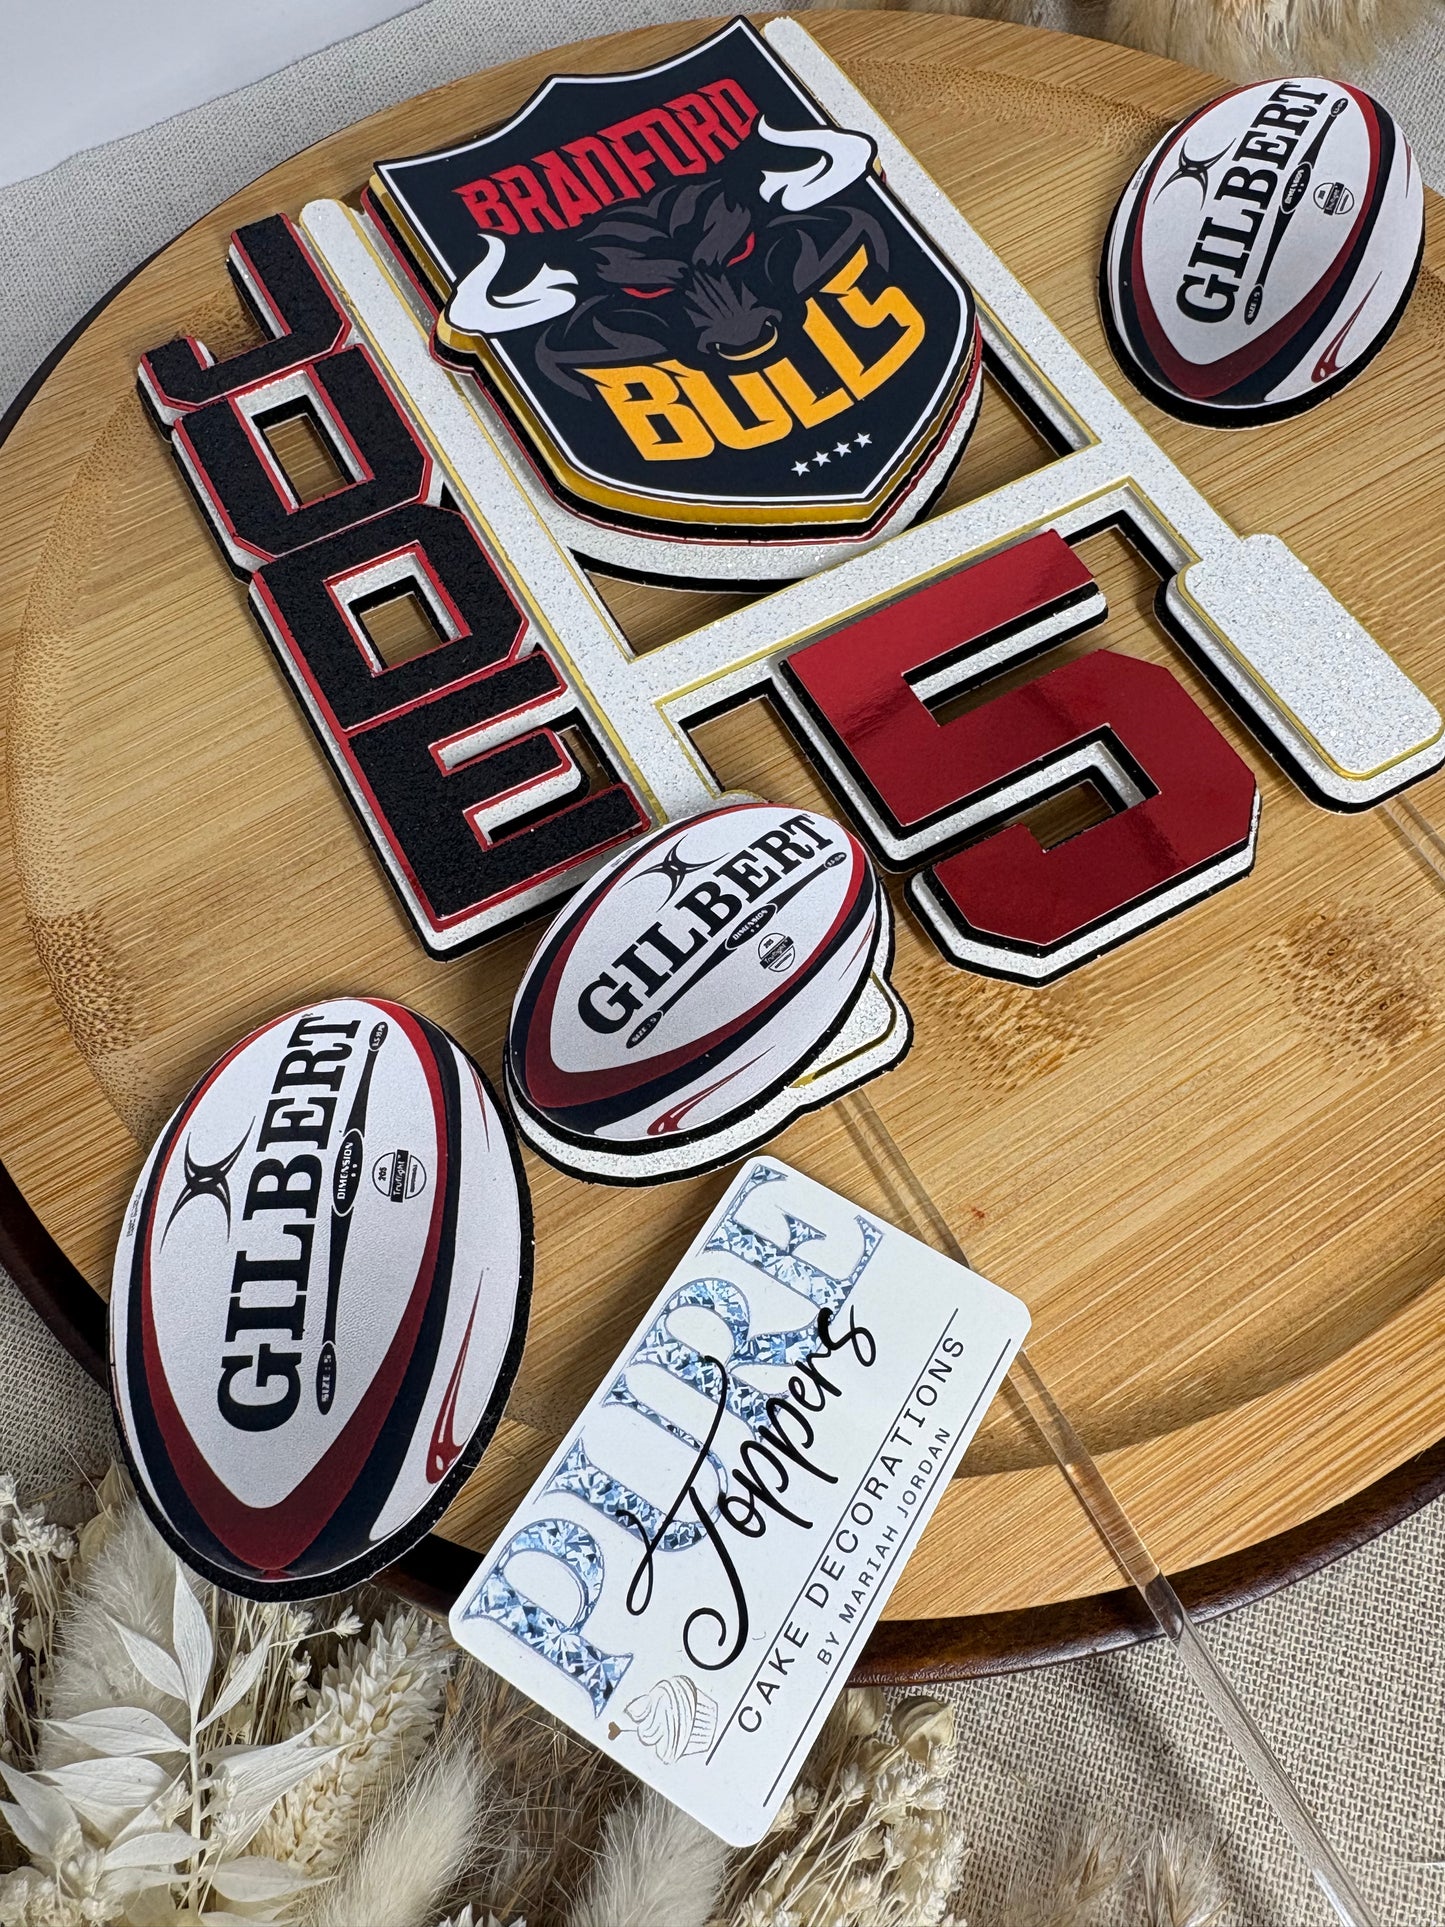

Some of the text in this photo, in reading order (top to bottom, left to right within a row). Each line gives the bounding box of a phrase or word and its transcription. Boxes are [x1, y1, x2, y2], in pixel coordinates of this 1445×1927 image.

[452, 78, 760, 235] BRADFORD
[1176, 80, 1329, 324] GILBERT
[577, 246, 926, 461] BULLS
[139, 211, 652, 932] JUDE
[787, 529, 1256, 945] 5
[577, 812, 835, 1035] GILBERT
[217, 1014, 362, 1433] GILBERT
[336, 1141, 354, 1200] DIMENSION
[457, 1164, 885, 1719] PURE
[614, 1303, 877, 1671] Toppers
[738, 1336, 964, 1733] CAKE DECORATIONS
[817, 1428, 951, 1666] BY MARIAH JORDAN
